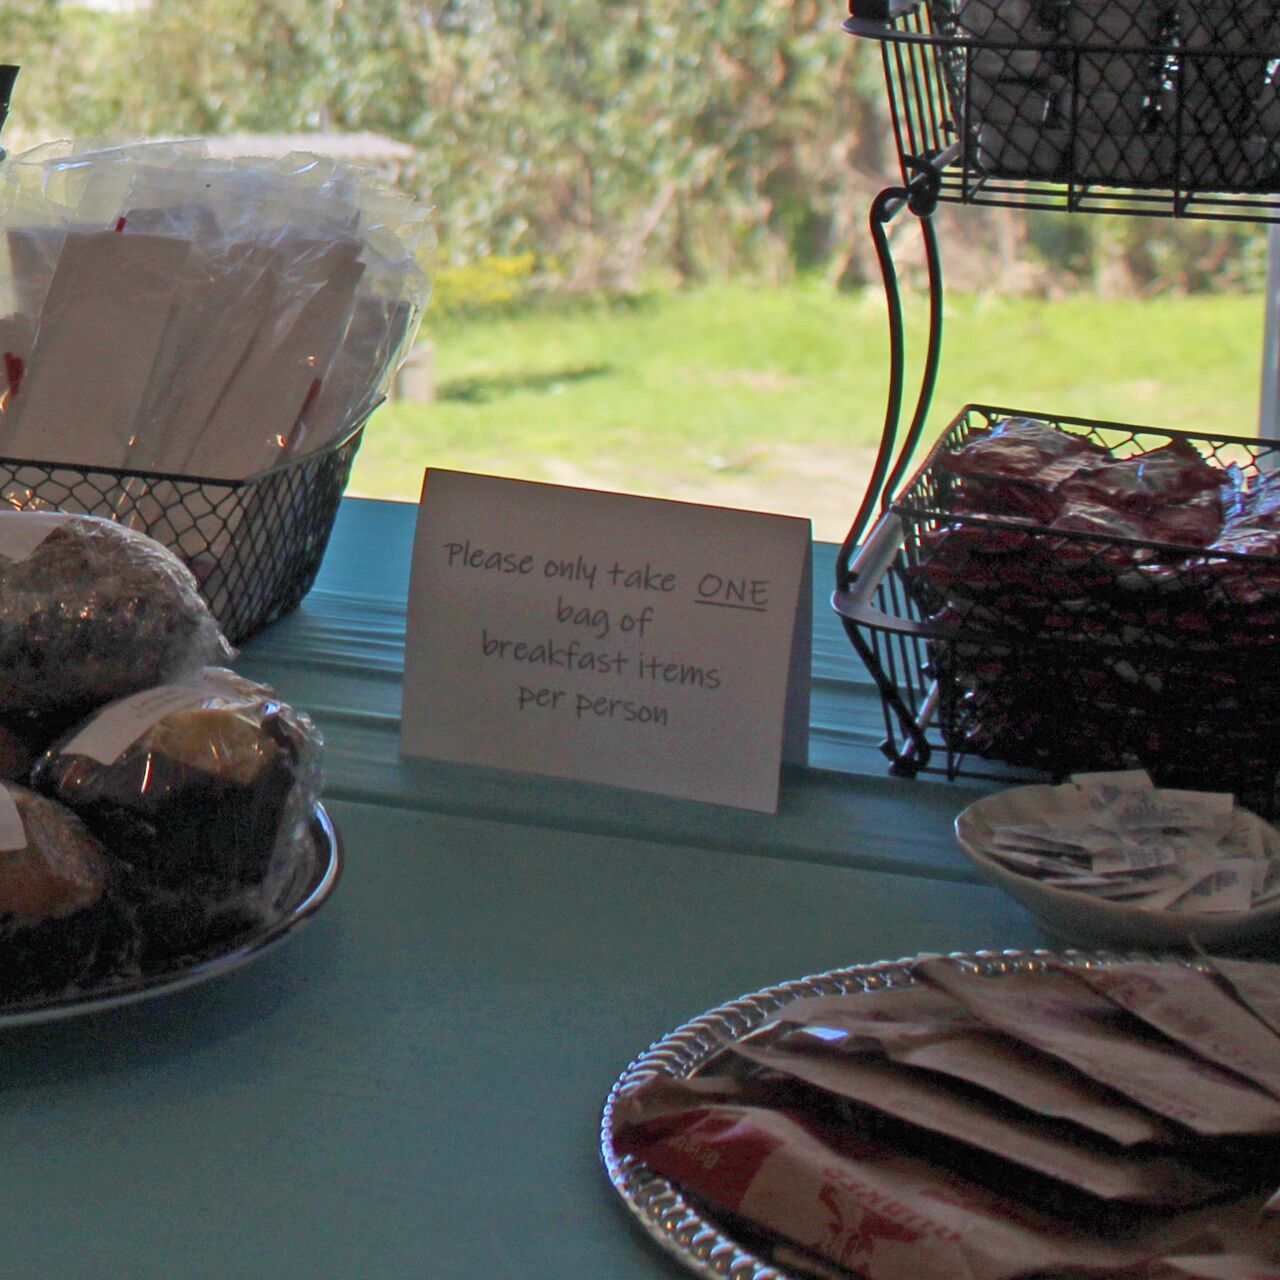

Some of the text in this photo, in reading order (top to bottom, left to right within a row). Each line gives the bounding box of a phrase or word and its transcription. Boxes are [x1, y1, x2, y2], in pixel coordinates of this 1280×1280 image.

[443, 541, 771, 607] Please only take ONE
[556, 595, 654, 638] bag of
[481, 629, 721, 690] breakfast items
[518, 685, 668, 727] per person
